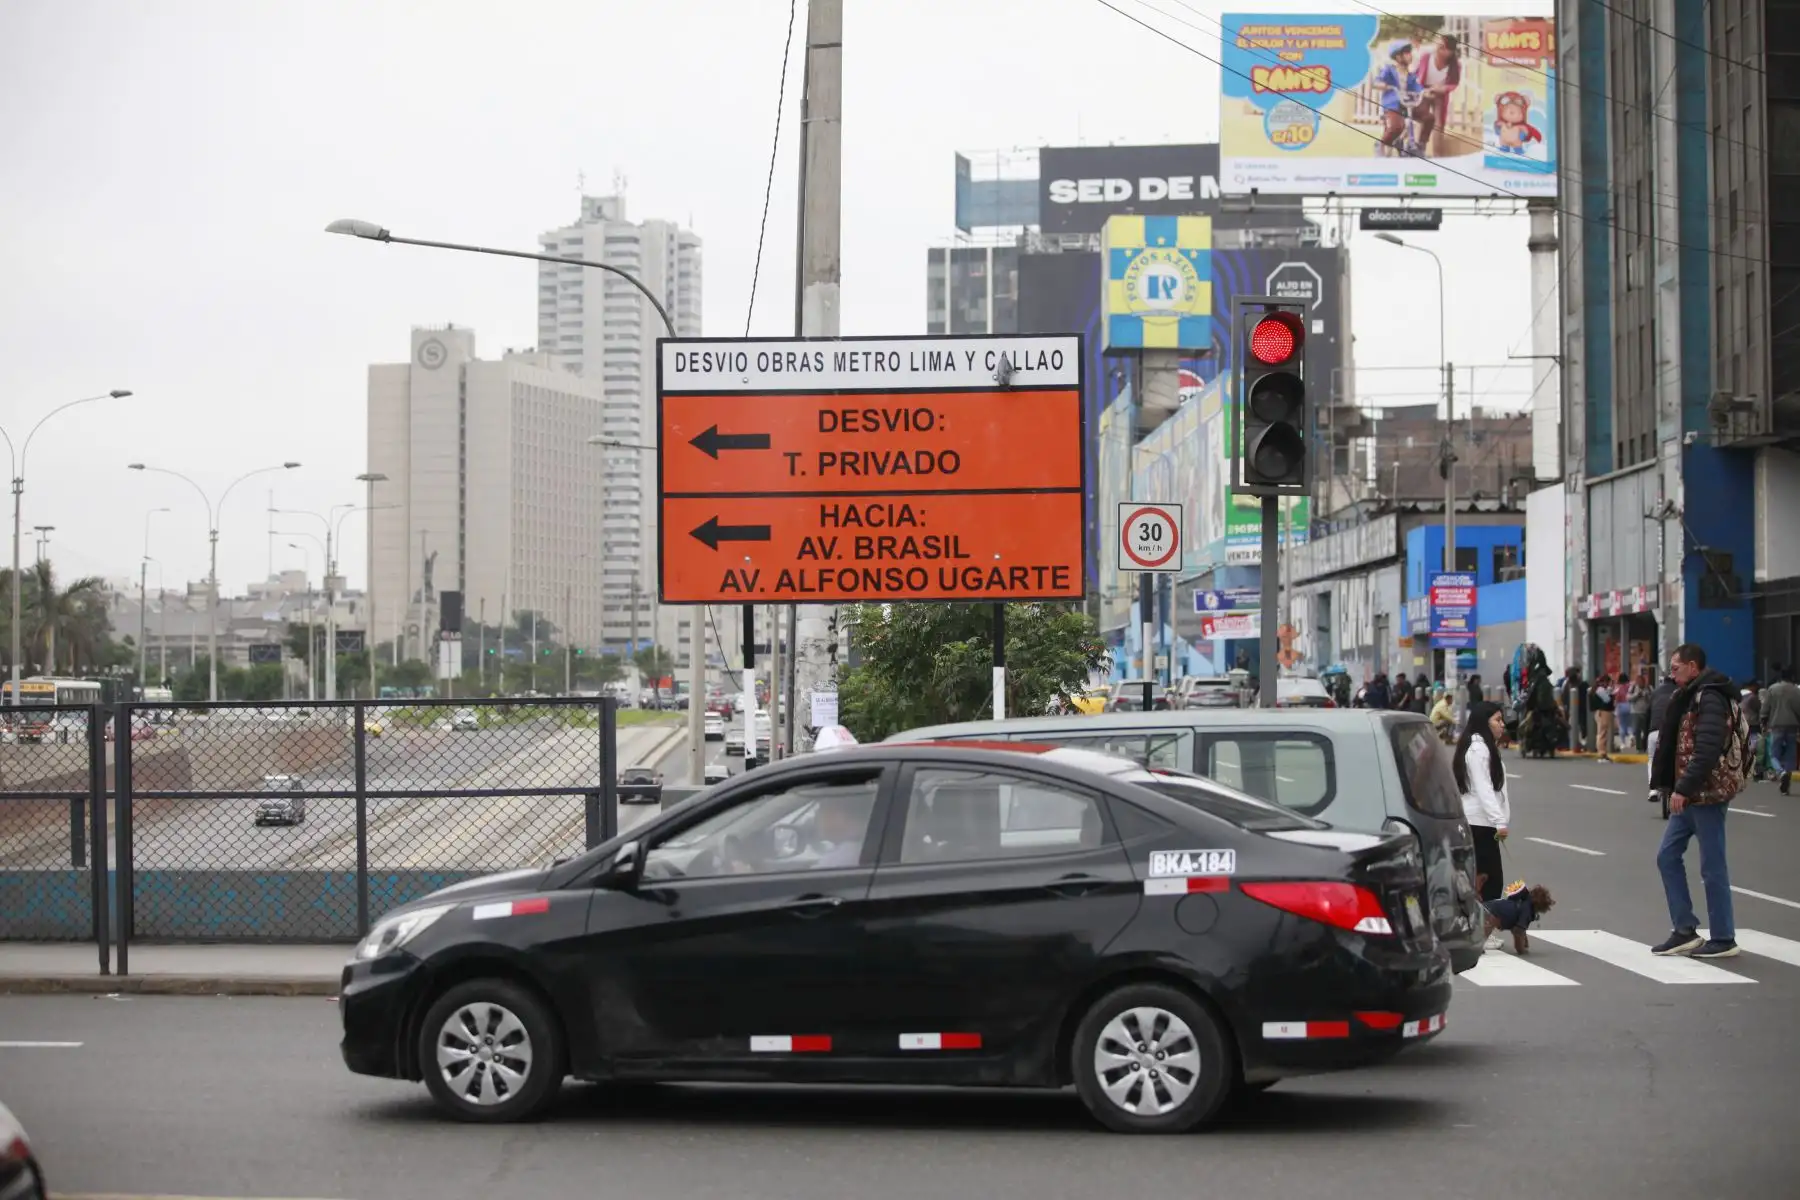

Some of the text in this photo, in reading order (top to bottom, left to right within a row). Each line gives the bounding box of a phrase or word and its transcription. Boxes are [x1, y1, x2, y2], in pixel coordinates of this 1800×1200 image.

[1049, 178, 1133, 204] SED
[1138, 176, 1194, 201] DE
[675, 350, 1064, 373] DESVIO OBRAS METRO LIMA Y CLLAO
[818, 408, 945, 433] DESVIO:
[783, 450, 961, 476] T. PRIVADO
[820, 504, 926, 528] HACIA:
[1139, 522, 1162, 542] 30
[796, 535, 971, 560] AV. BRASIL
[719, 566, 1070, 593] AV. ALFONSO UGARTE
[1153, 852, 1231, 874] BKA-184
